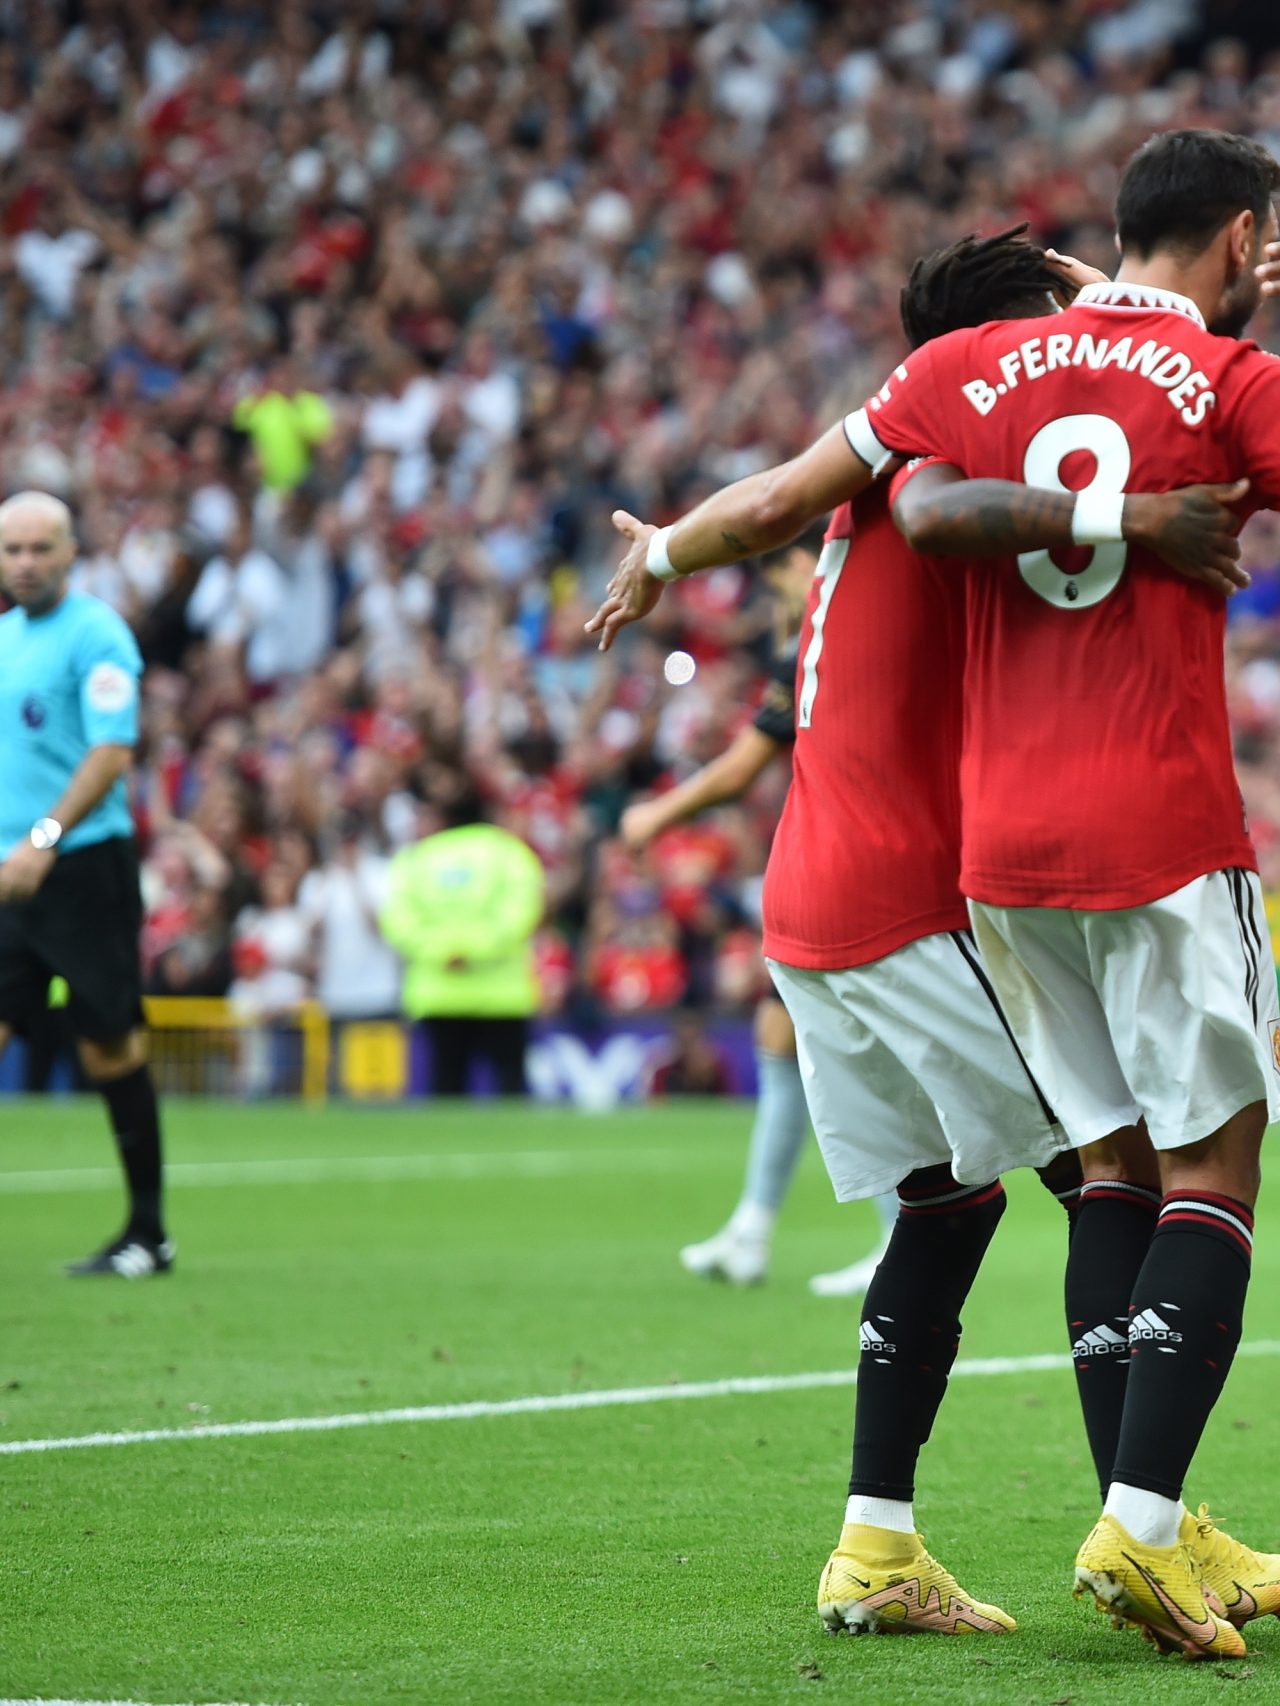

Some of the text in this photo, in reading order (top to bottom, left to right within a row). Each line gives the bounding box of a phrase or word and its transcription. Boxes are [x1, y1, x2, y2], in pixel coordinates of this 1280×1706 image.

[961, 333, 1216, 426] B.FERNANDES
[1017, 413, 1132, 610] 8
[1071, 1342, 1132, 1358] adida
